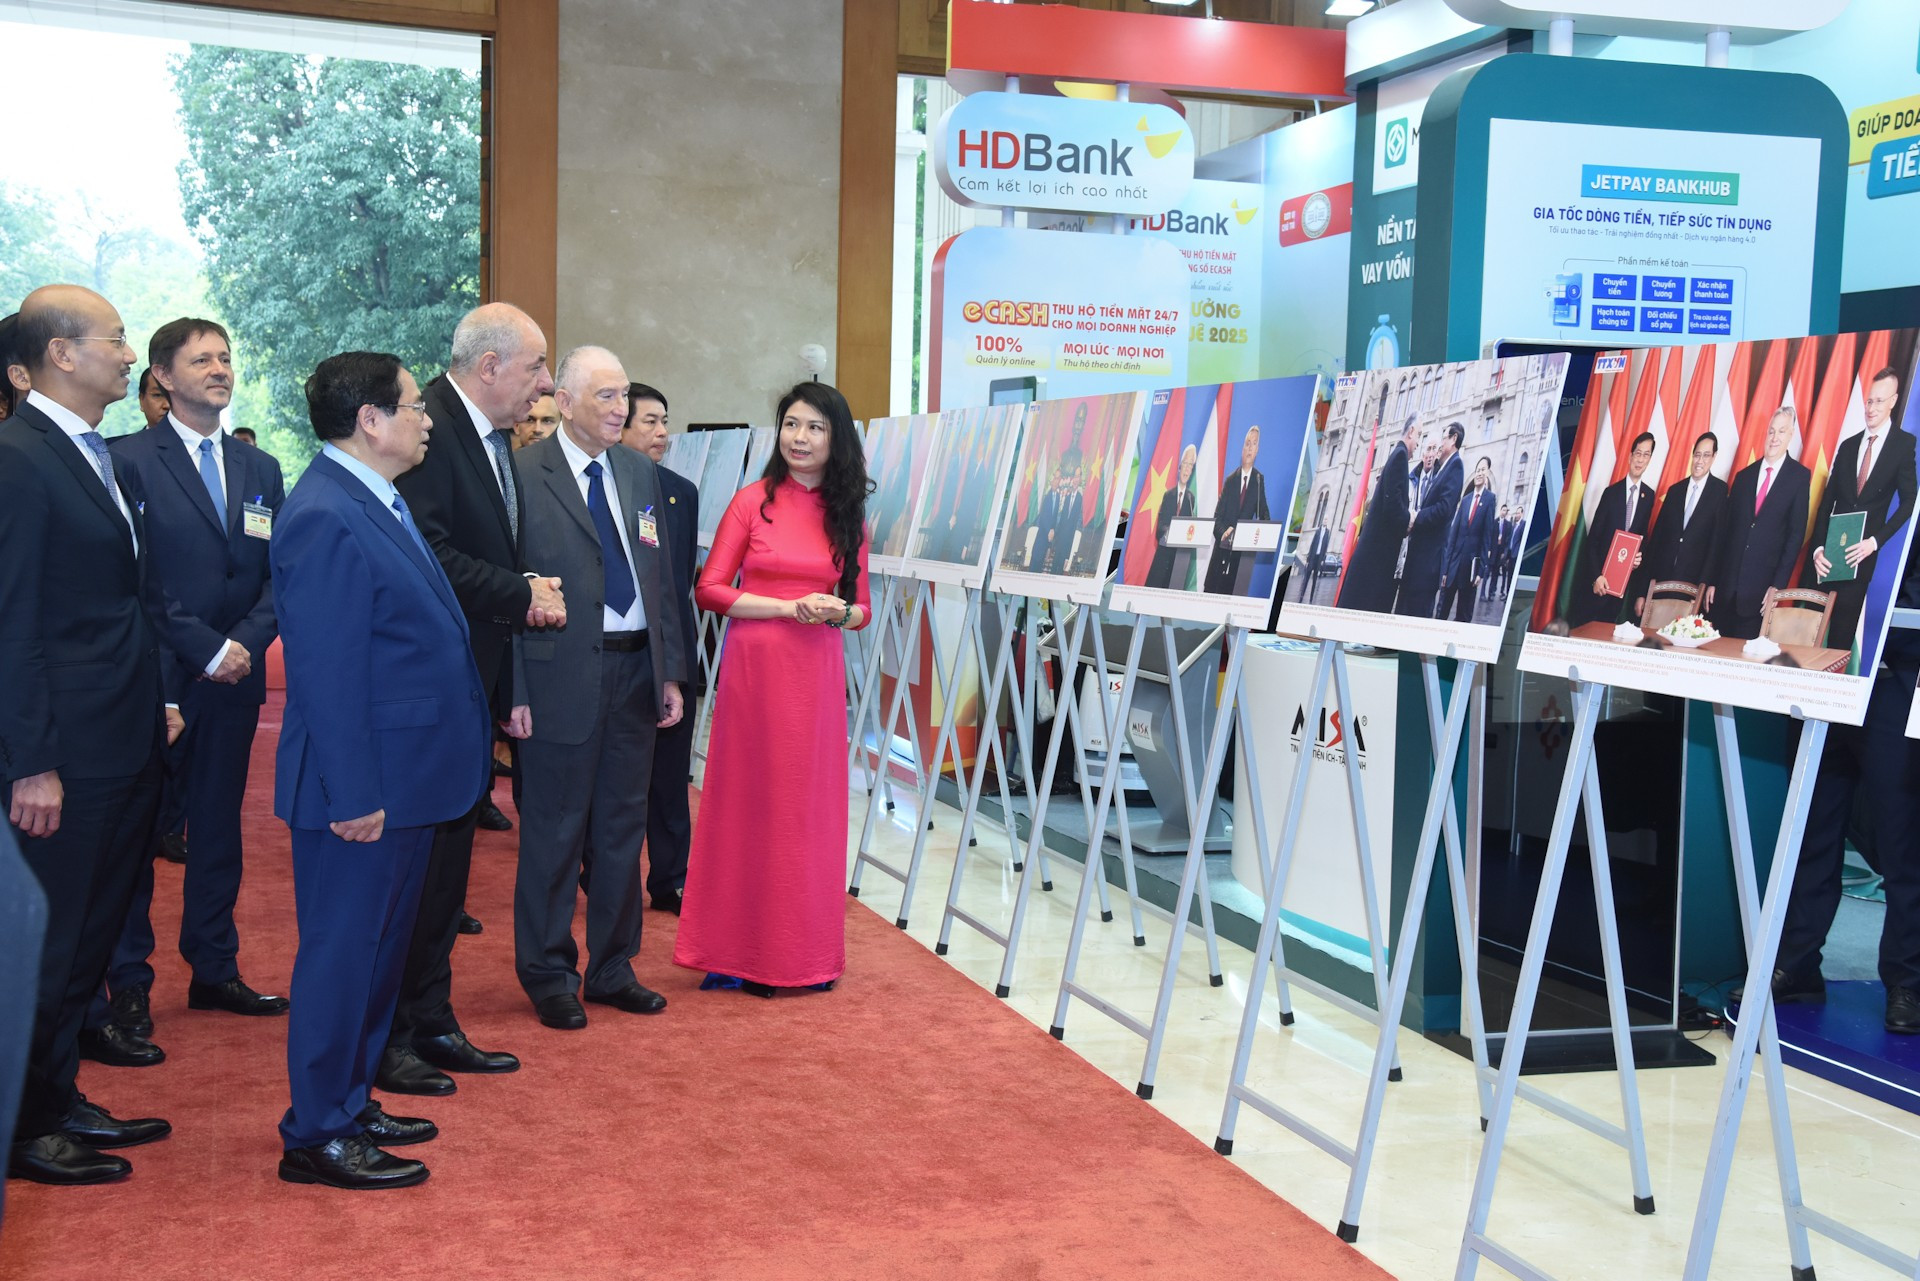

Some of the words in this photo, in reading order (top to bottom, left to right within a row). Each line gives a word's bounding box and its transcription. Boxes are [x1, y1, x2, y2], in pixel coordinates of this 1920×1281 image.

[1857, 112, 1891, 138] GIÚP
[958, 129, 1134, 177] HDBank
[1881, 140, 1920, 182] TIẾ
[958, 176, 990, 191] Cam
[997, 178, 1021, 193] kết
[1028, 180, 1047, 196] lợi
[1054, 182, 1074, 196] ích
[1082, 186, 1108, 197] cao
[1115, 185, 1148, 199] nhất
[1590, 174, 1652, 193] JETPAY
[1655, 177, 1731, 197] BANKHUB
[1533, 207, 1555, 220] GIA
[1558, 205, 1583, 221] TỐC
[1585, 207, 1620, 223] DÒNG
[1658, 211, 1686, 227] TIẾP
[1688, 213, 1713, 228] SỨC
[1716, 215, 1736, 229] TÍN
[1738, 218, 1772, 234] DỤNG
[1210, 265, 1232, 275] ECASH
[1362, 261, 1384, 285] VAY
[1386, 251, 1410, 281] VỐN
[963, 299, 1049, 327] eCASH
[1053, 304, 1074, 315] THU
[1078, 304, 1096, 319] HỘ
[1154, 310, 1179, 321] 24/7
[1052, 320, 1073, 329] CHO
[1076, 321, 1096, 333] MỌI
[1100, 322, 1136, 333] DOANH
[1139, 324, 1176, 337] NGHIỆP
[1209, 327, 1248, 344] 2025
[976, 335, 1023, 353] 100%
[1064, 343, 1087, 356] MỌI
[1090, 342, 1109, 355] LÚC
[1117, 346, 1140, 359] MỌI
[976, 354, 999, 365] Quản
[1000, 356, 1008, 367] lý
[1009, 357, 1036, 366] online
[1064, 359, 1078, 367] Thu
[1080, 359, 1090, 369] hộ
[1091, 361, 1109, 369] theo
[1123, 363, 1141, 372] định
